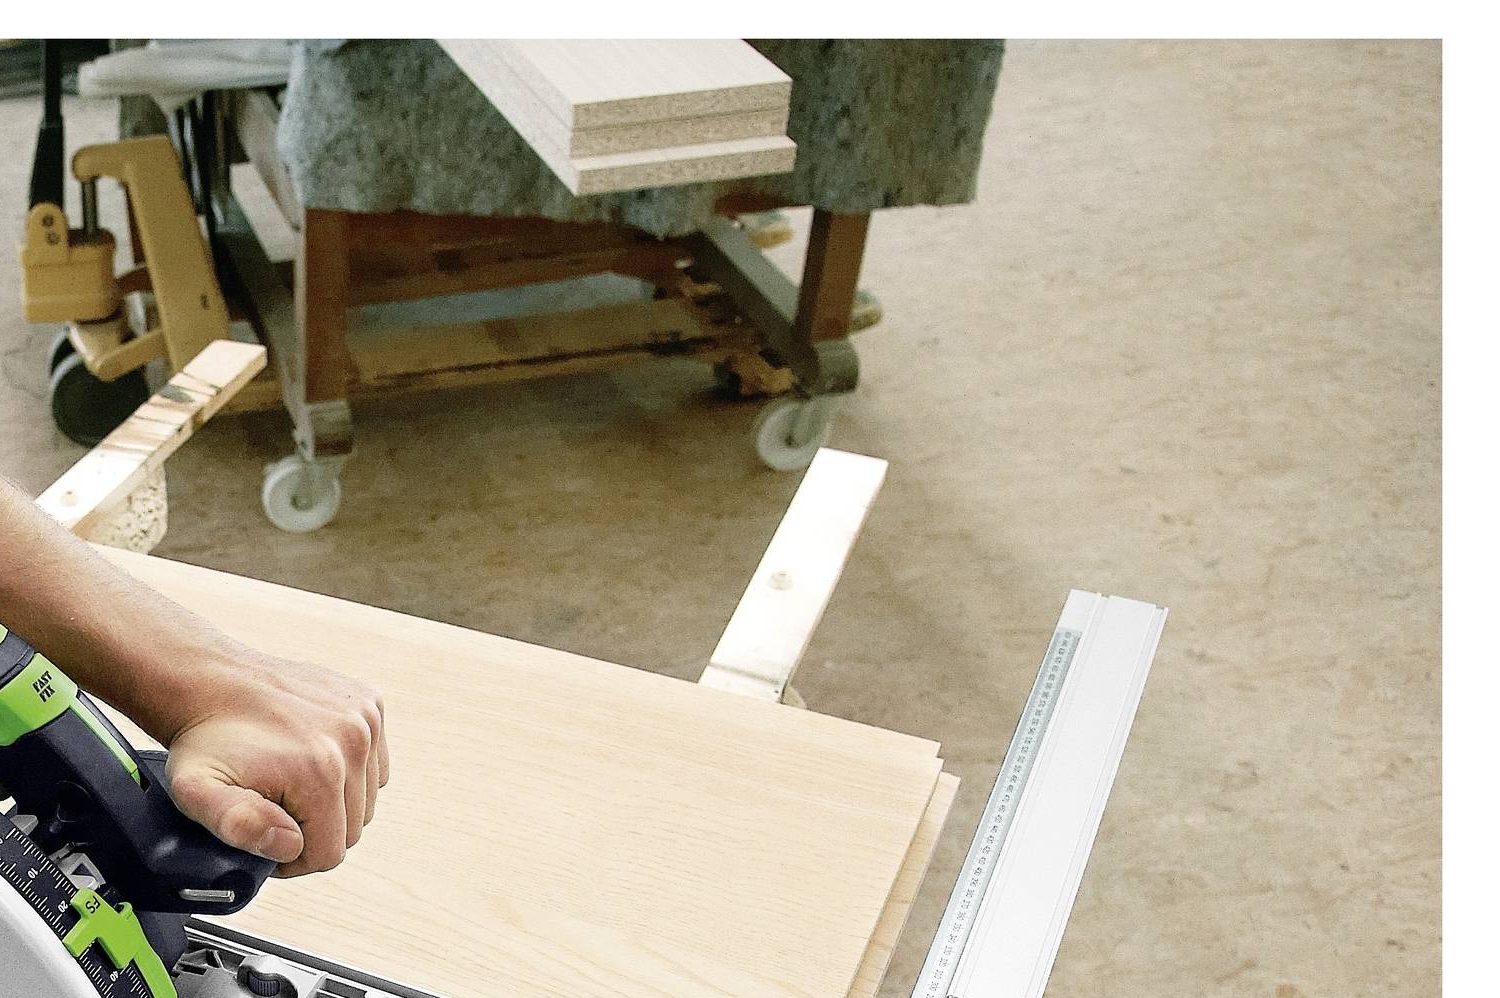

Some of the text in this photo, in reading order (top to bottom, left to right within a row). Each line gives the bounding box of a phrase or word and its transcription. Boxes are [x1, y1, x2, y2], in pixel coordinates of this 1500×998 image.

[33, 670, 52, 693] FAST
[39, 684, 56, 702] FIX
[27, 867, 39, 879] 10
[57, 900, 68, 913] 20
[85, 895, 101, 914] FS
[109, 970, 119, 982] 40
